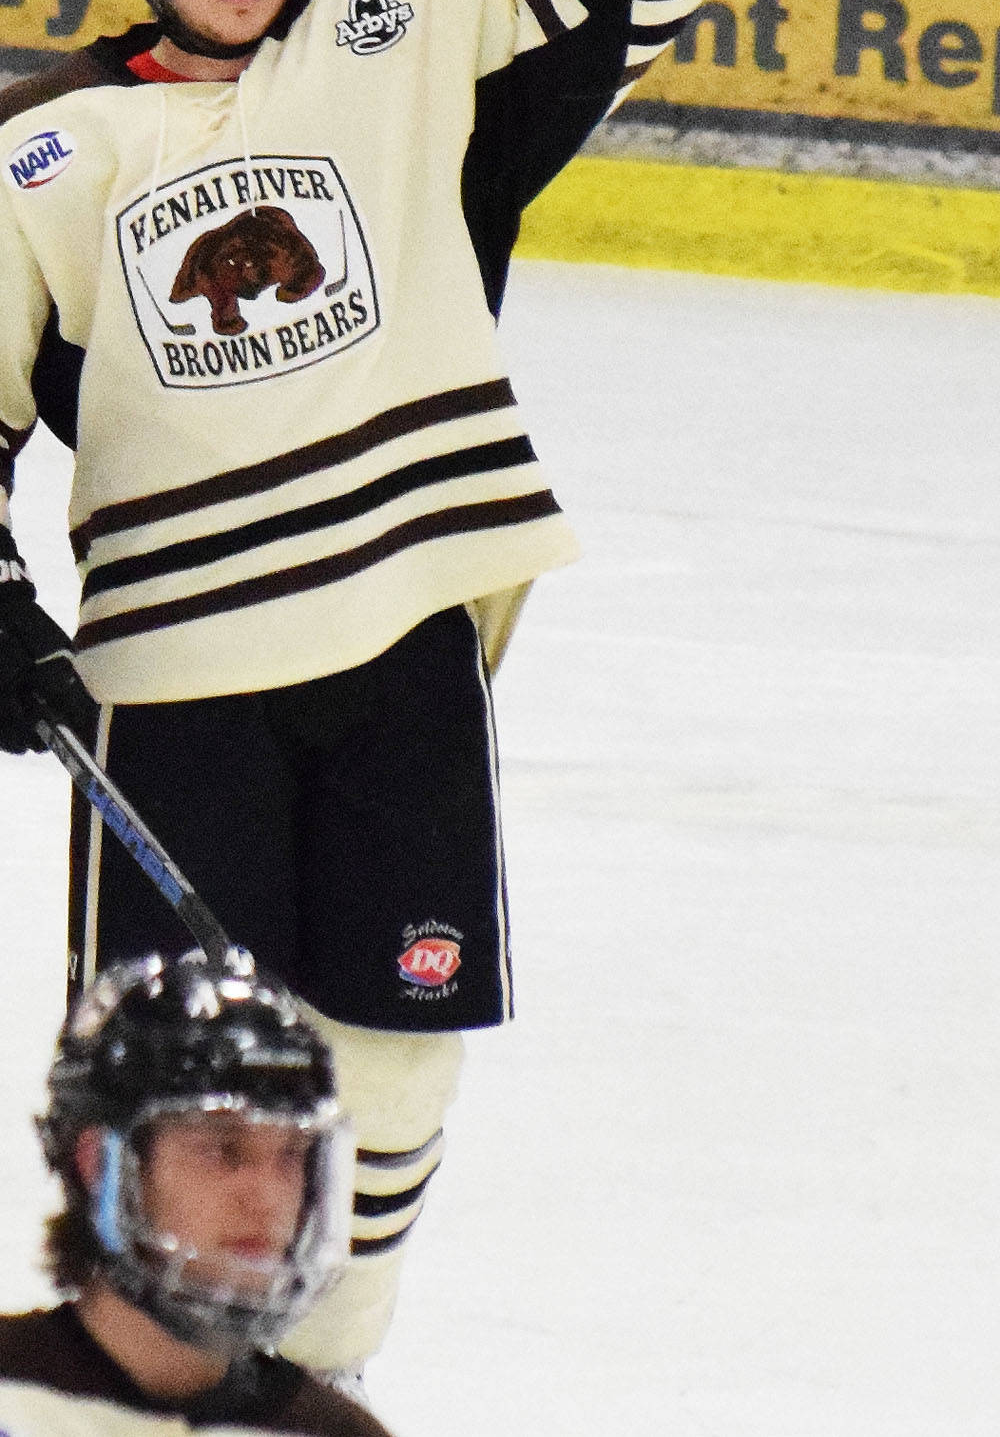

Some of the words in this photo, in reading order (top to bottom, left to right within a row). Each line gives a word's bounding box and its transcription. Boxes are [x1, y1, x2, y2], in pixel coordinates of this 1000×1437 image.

[9, 137, 73, 186] NAHL
[129, 176, 229, 254] KENAI
[229, 167, 335, 204] RIVER
[161, 333, 274, 378] BROWN
[275, 289, 368, 361] BEARS
[410, 949, 454, 976] DQ
